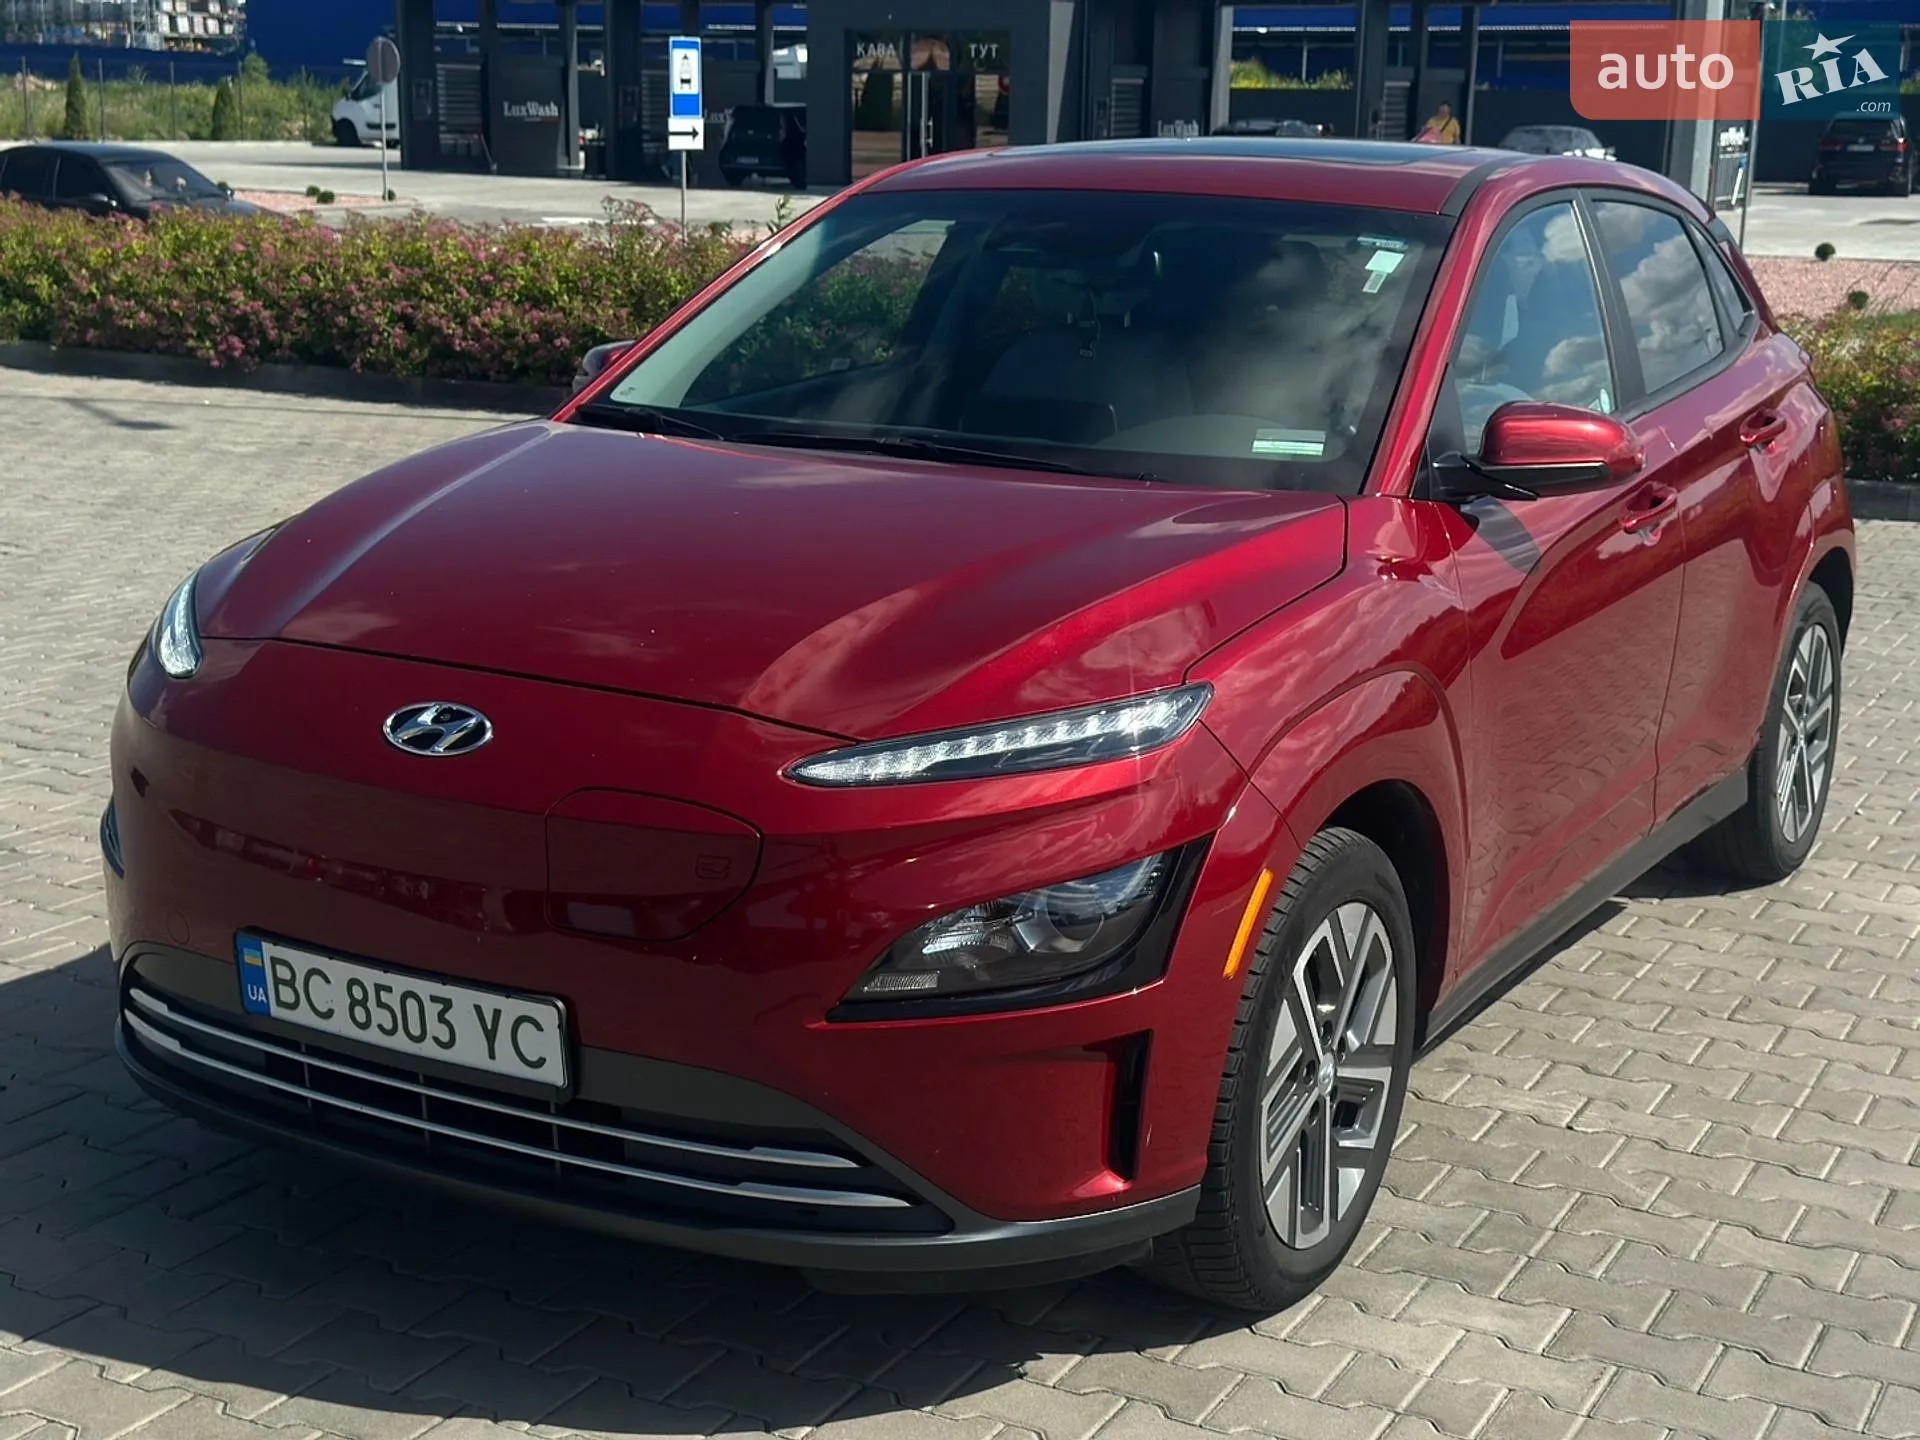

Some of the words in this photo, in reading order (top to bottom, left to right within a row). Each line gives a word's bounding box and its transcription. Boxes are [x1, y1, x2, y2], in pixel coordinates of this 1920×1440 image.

[968, 43, 1000, 60] ТУТ
[503, 100, 559, 117] LuxWash
[247, 983, 268, 1004] UA
[270, 955, 335, 1020] BC
[346, 977, 456, 1050] 8503
[473, 1003, 547, 1069] YC
